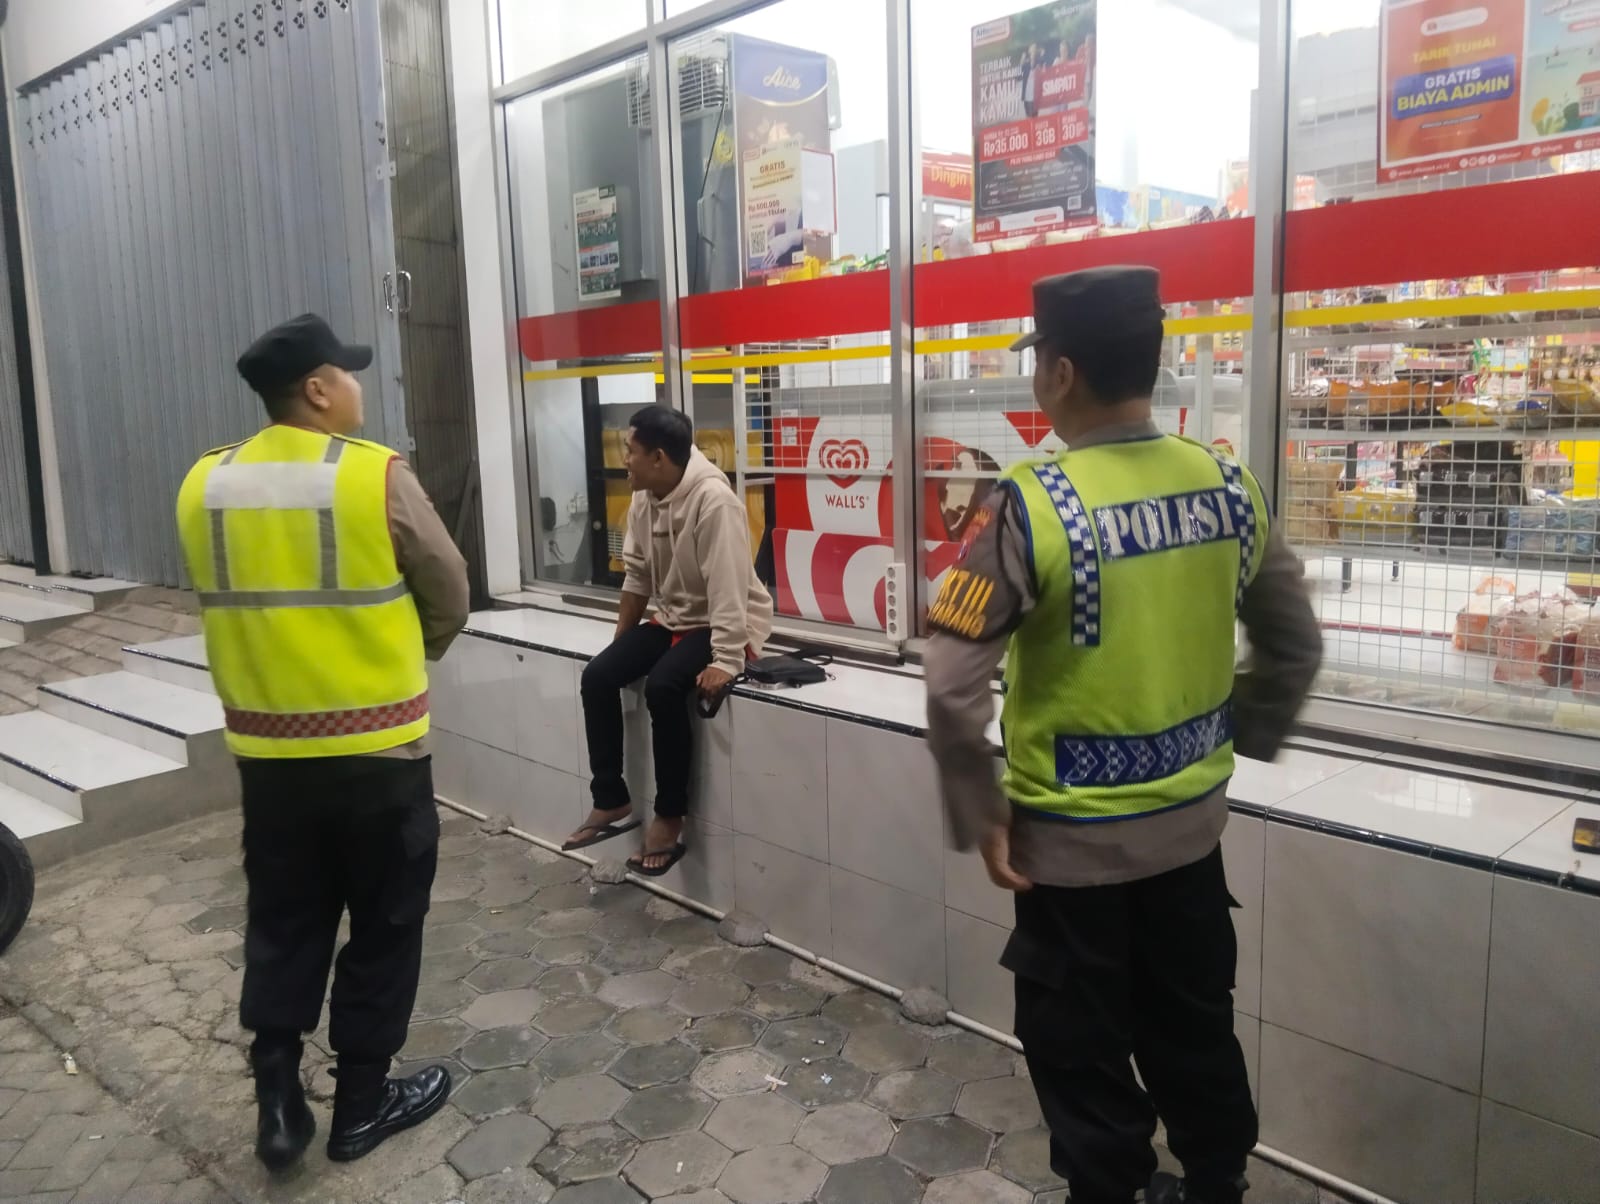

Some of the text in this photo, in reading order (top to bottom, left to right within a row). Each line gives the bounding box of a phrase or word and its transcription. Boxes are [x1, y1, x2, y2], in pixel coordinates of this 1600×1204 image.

[1425, 67, 1481, 89] GRATIS
[1397, 75, 1510, 111] BIAYA ADMIN
[825, 494, 865, 509] WALL'S
[1099, 491, 1235, 557] POLISI
